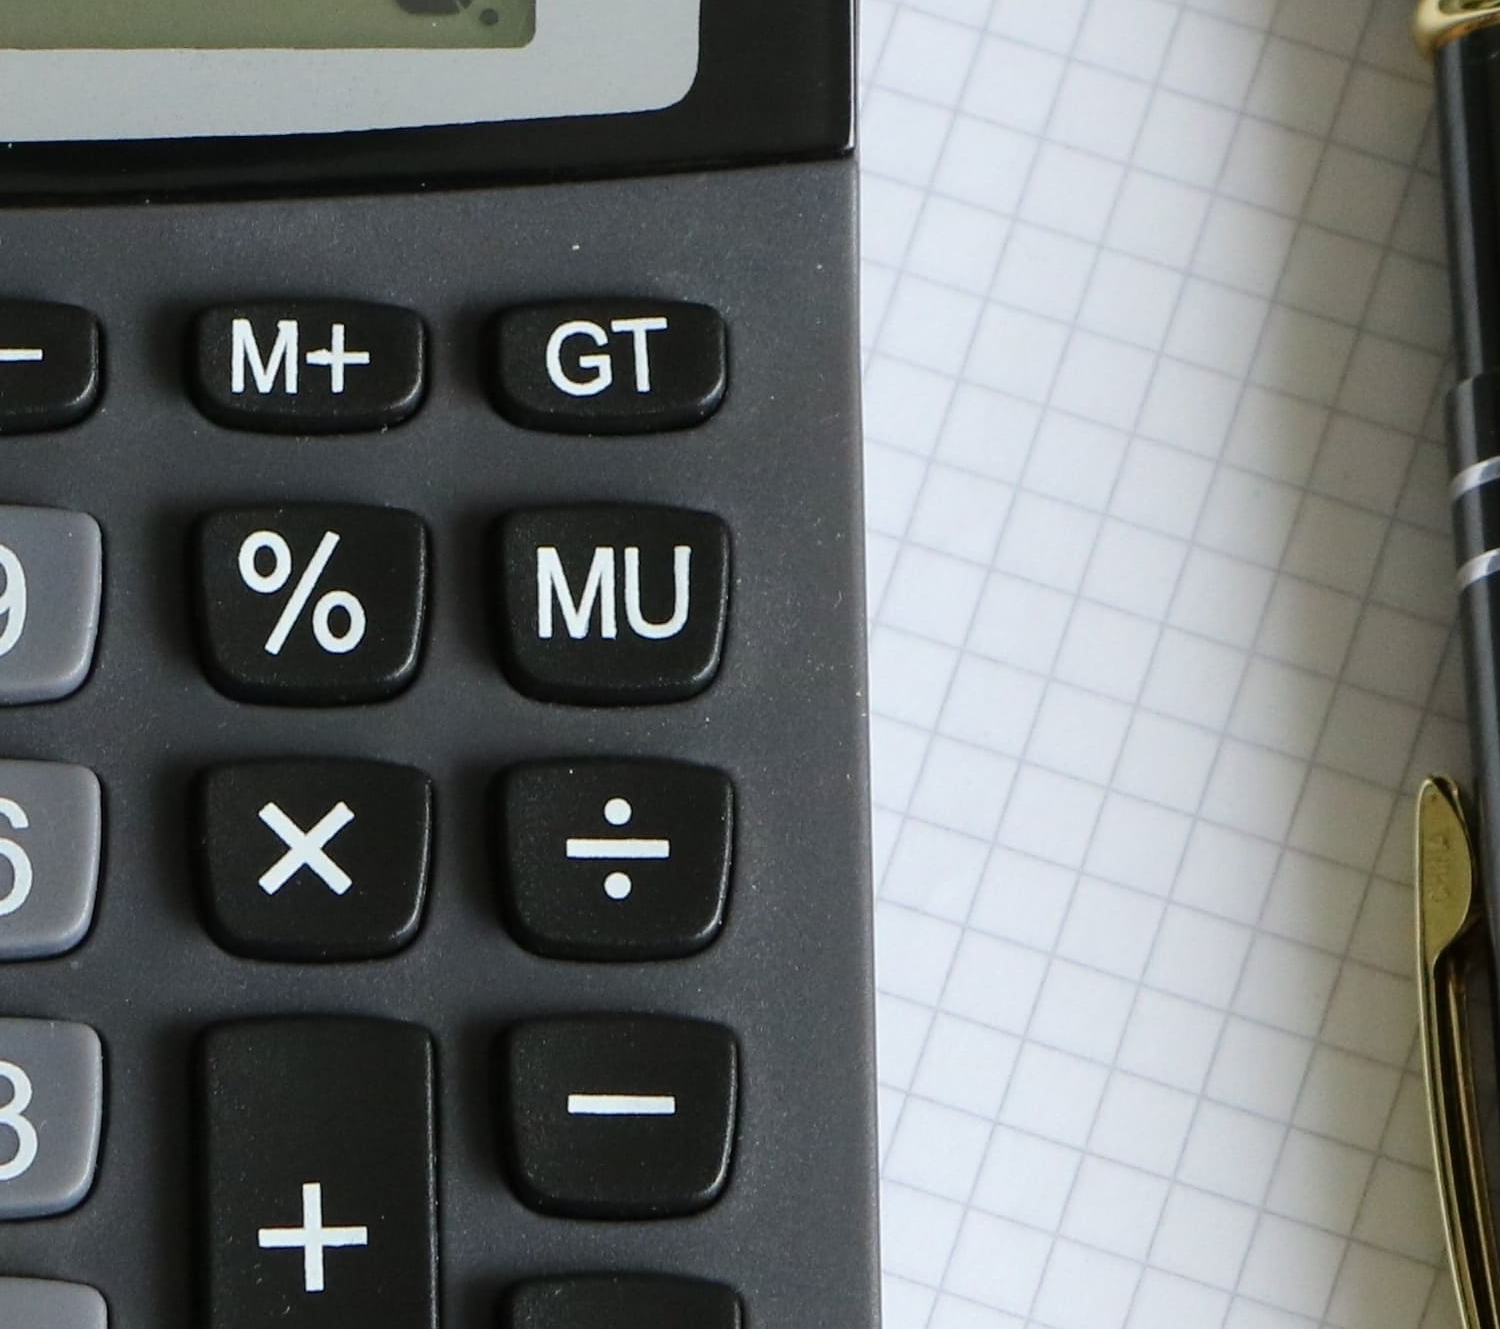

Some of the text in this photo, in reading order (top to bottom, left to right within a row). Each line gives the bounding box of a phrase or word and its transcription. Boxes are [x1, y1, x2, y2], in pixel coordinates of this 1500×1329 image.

[232, 319, 370, 393] M+
[546, 317, 668, 396] GT
[537, 546, 691, 639] MU
